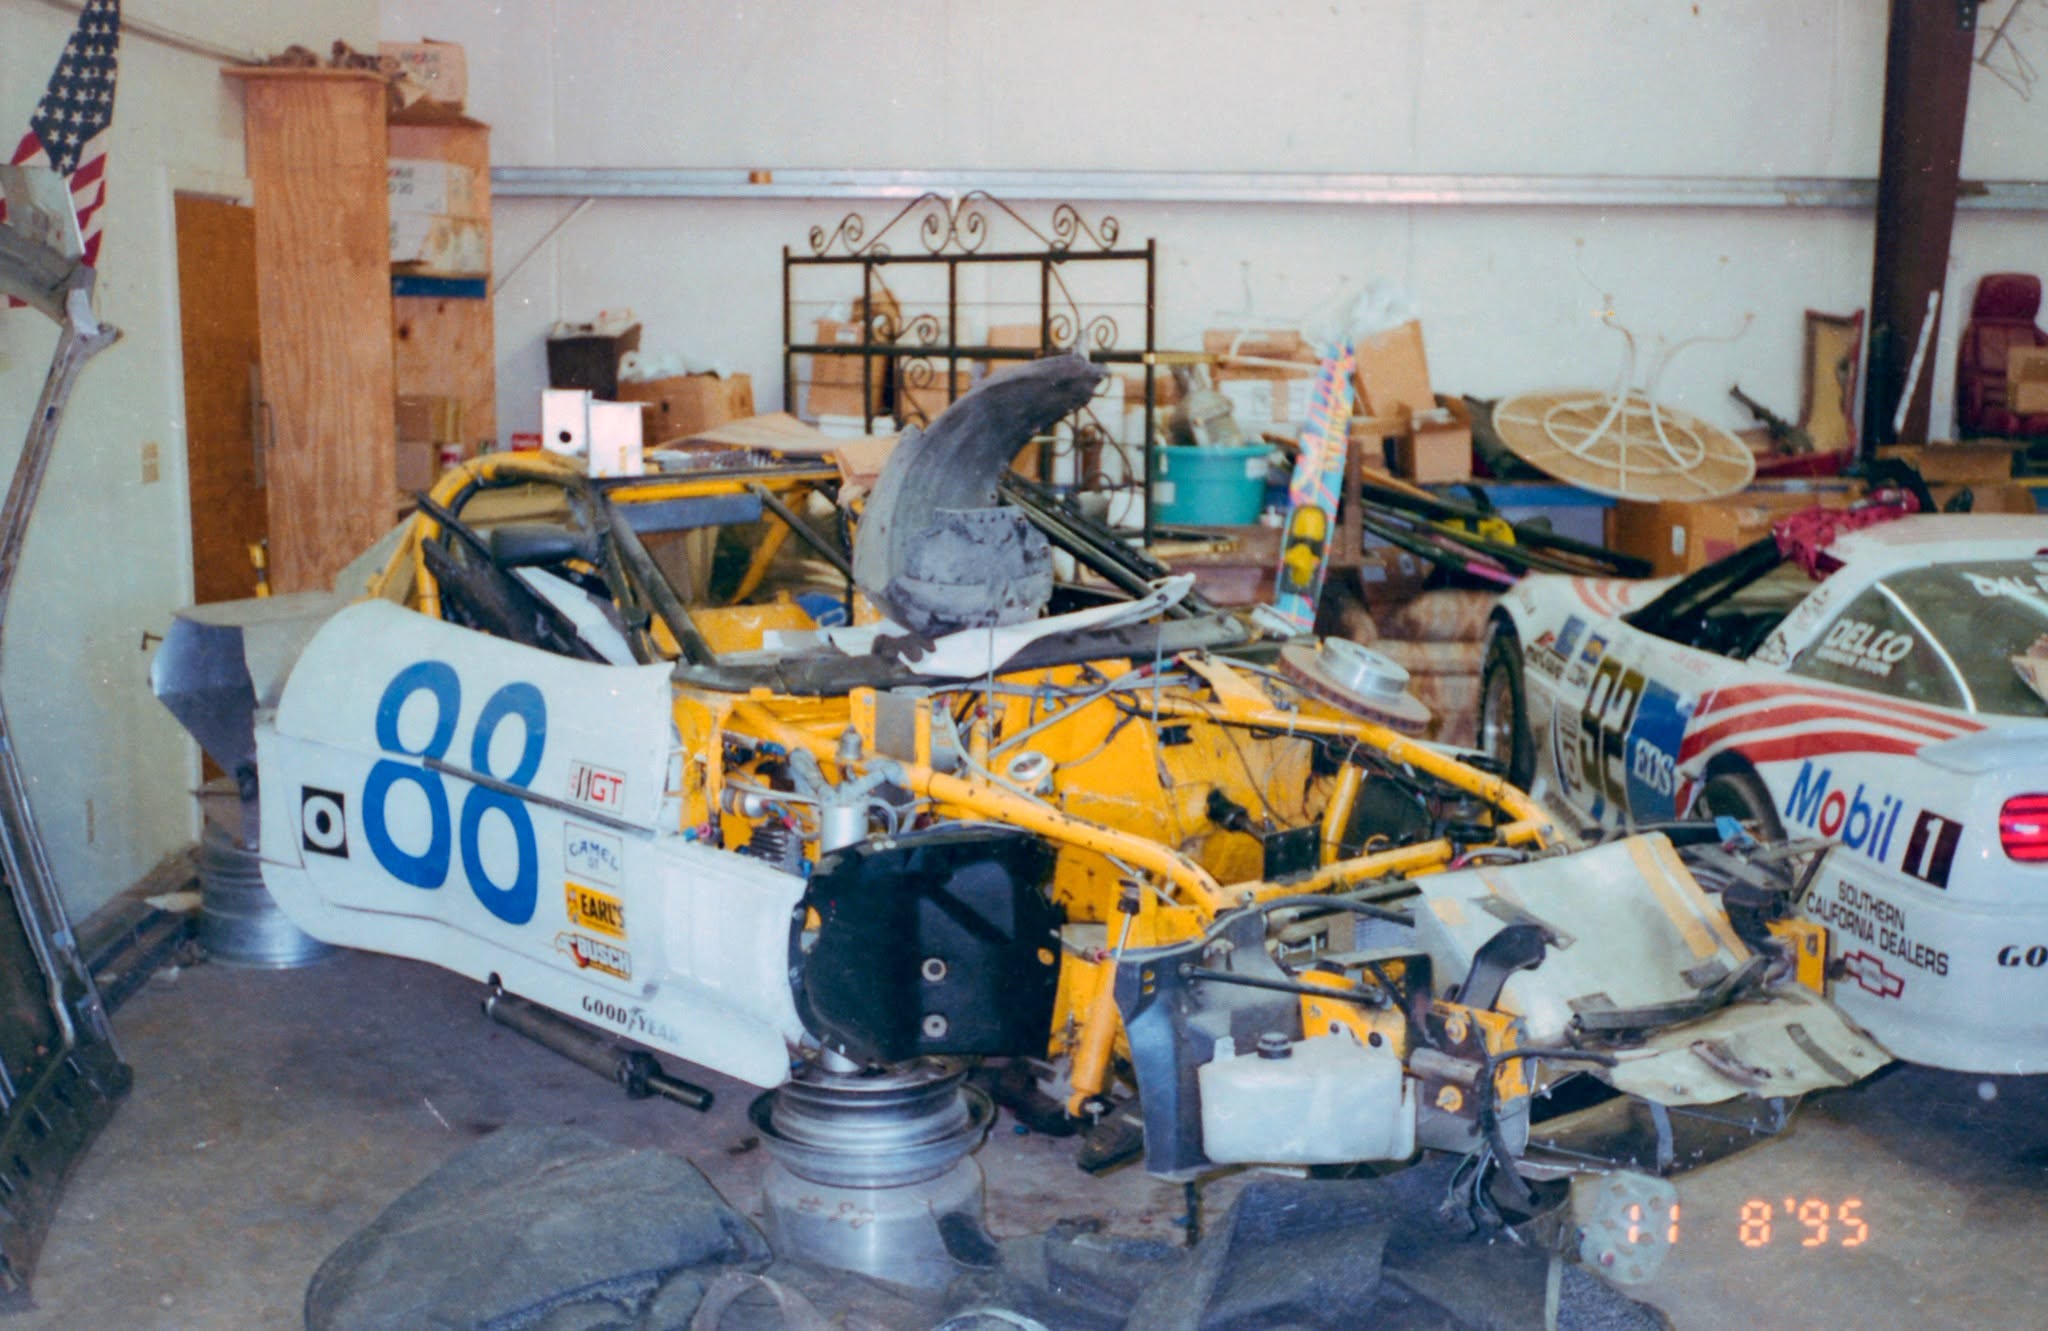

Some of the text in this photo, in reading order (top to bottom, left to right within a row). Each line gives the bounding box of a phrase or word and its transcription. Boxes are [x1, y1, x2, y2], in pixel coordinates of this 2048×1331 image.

[1826, 618, 1914, 663] DELCO
[363, 660, 547, 926] 88
[1634, 738, 1676, 797] EDS
[1784, 760, 1945, 882] Mobil 1
[568, 839, 619, 872] CAMEL
[580, 893, 625, 929] EARL'S
[1838, 879, 1905, 931] SOUTHERN
[1806, 890, 1949, 976] CALIFORNIA DEALERS
